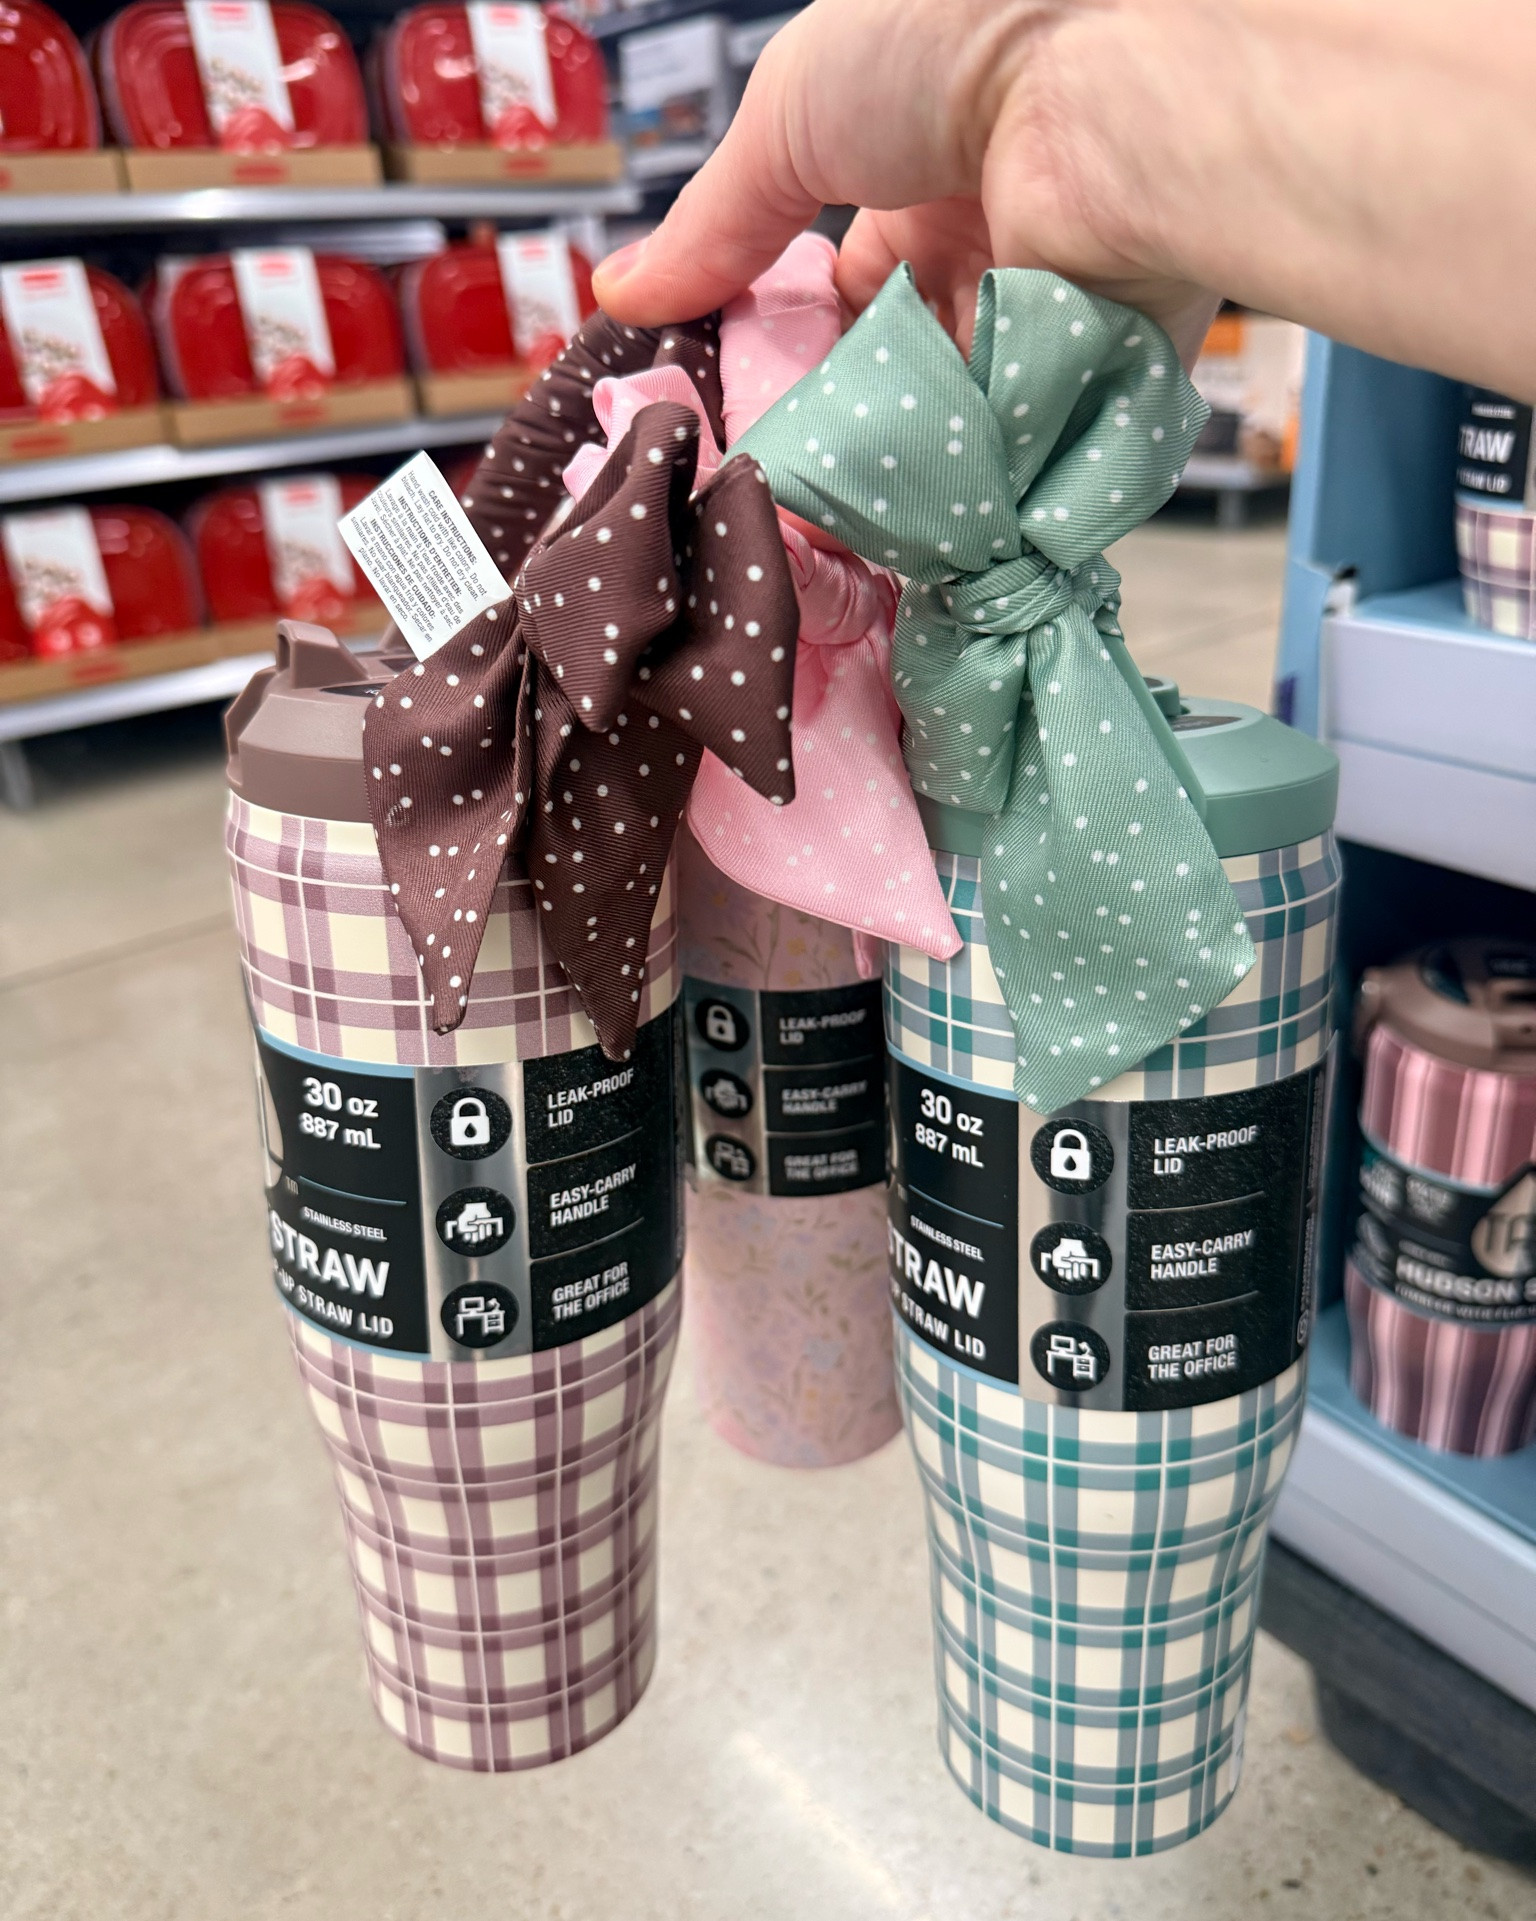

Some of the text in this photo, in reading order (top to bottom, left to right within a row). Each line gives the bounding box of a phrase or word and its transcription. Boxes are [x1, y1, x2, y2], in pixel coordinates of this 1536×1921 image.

[396, 495, 463, 597] INSTRUCTIONS D'ENTRETIEN:
[399, 475, 418, 500] bleach.
[412, 498, 425, 514] Lay
[421, 511, 432, 526] flat
[432, 531, 446, 548] dry.
[448, 555, 459, 569] not
[455, 567, 467, 582] dry
[463, 579, 480, 602] clean.
[406, 470, 421, 489] Hand
[416, 487, 431, 507] wash
[427, 506, 440, 523] cold
[436, 520, 450, 538] with
[446, 536, 458, 550] like
[454, 549, 473, 574] colors.
[475, 582, 487, 596] not
[427, 489, 478, 565] CARE INSTRUCTIONS:
[369, 517, 407, 575] INSTRUCCIONES
[411, 583, 436, 620] CUIDADO:
[374, 489, 395, 518] couleurs
[390, 515, 415, 551] similaires.
[417, 560, 428, 575] pas
[425, 572, 444, 597] utiliser
[440, 595, 456, 616] d'eau
[379, 513, 397, 538] Sécher
[412, 568, 424, 583] pas
[421, 580, 442, 610] nettoyer
[382, 487, 402, 514] Lavage
[405, 524, 419, 543] main
[419, 547, 433, 566] l'eau
[429, 563, 446, 586] froide
[442, 584, 455, 602] avec
[452, 600, 464, 614] des
[359, 516, 374, 537] Lavar
[373, 540, 388, 561] mano
[385, 559, 396, 574] con
[392, 572, 407, 591] agua
[415, 605, 435, 632] colores
[374, 556, 387, 573] usar
[411, 612, 427, 634] Secar
[378, 576, 391, 595] lavar
[779, 1009, 867, 1031] LEAK-PROOF
[780, 1031, 805, 1045] LID
[303, 1075, 379, 1119] 30 oz
[547, 1069, 636, 1110] LEAK-PROOF
[781, 1080, 868, 1101] EASY-CARRY
[782, 1100, 838, 1115] HANDLE
[300, 1111, 381, 1149] 887 mL
[548, 1109, 575, 1128] LID
[920, 1088, 983, 1136] 30 oz
[784, 1150, 858, 1169] GREAT FOR
[915, 1122, 984, 1168] 887 mL
[1153, 1125, 1258, 1156] LEAK-PROOF
[549, 1163, 638, 1209] EASY-CARRY
[786, 1162, 859, 1180] THE OFFICE
[1154, 1156, 1183, 1175] LID
[303, 1206, 388, 1241] STAINLESS STEEL
[550, 1197, 611, 1227] HANDLE
[271, 1209, 390, 1300] STRAW
[909, 1215, 985, 1262] STAINLESS STEEL
[1150, 1230, 1254, 1261] EASY-CARRY
[553, 1261, 630, 1304] GREAT FOR
[1150, 1258, 1218, 1281] HANDLE
[1396, 1254, 1518, 1304] HUDSON
[299, 1285, 353, 1328] STRAW
[358, 1312, 395, 1338] LID
[553, 1278, 631, 1323] THE OFFICE
[902, 1291, 987, 1360] STRAW LID
[1147, 1352, 1236, 1381] THE OFFICE
[1148, 1334, 1235, 1363] GREAT FOR
